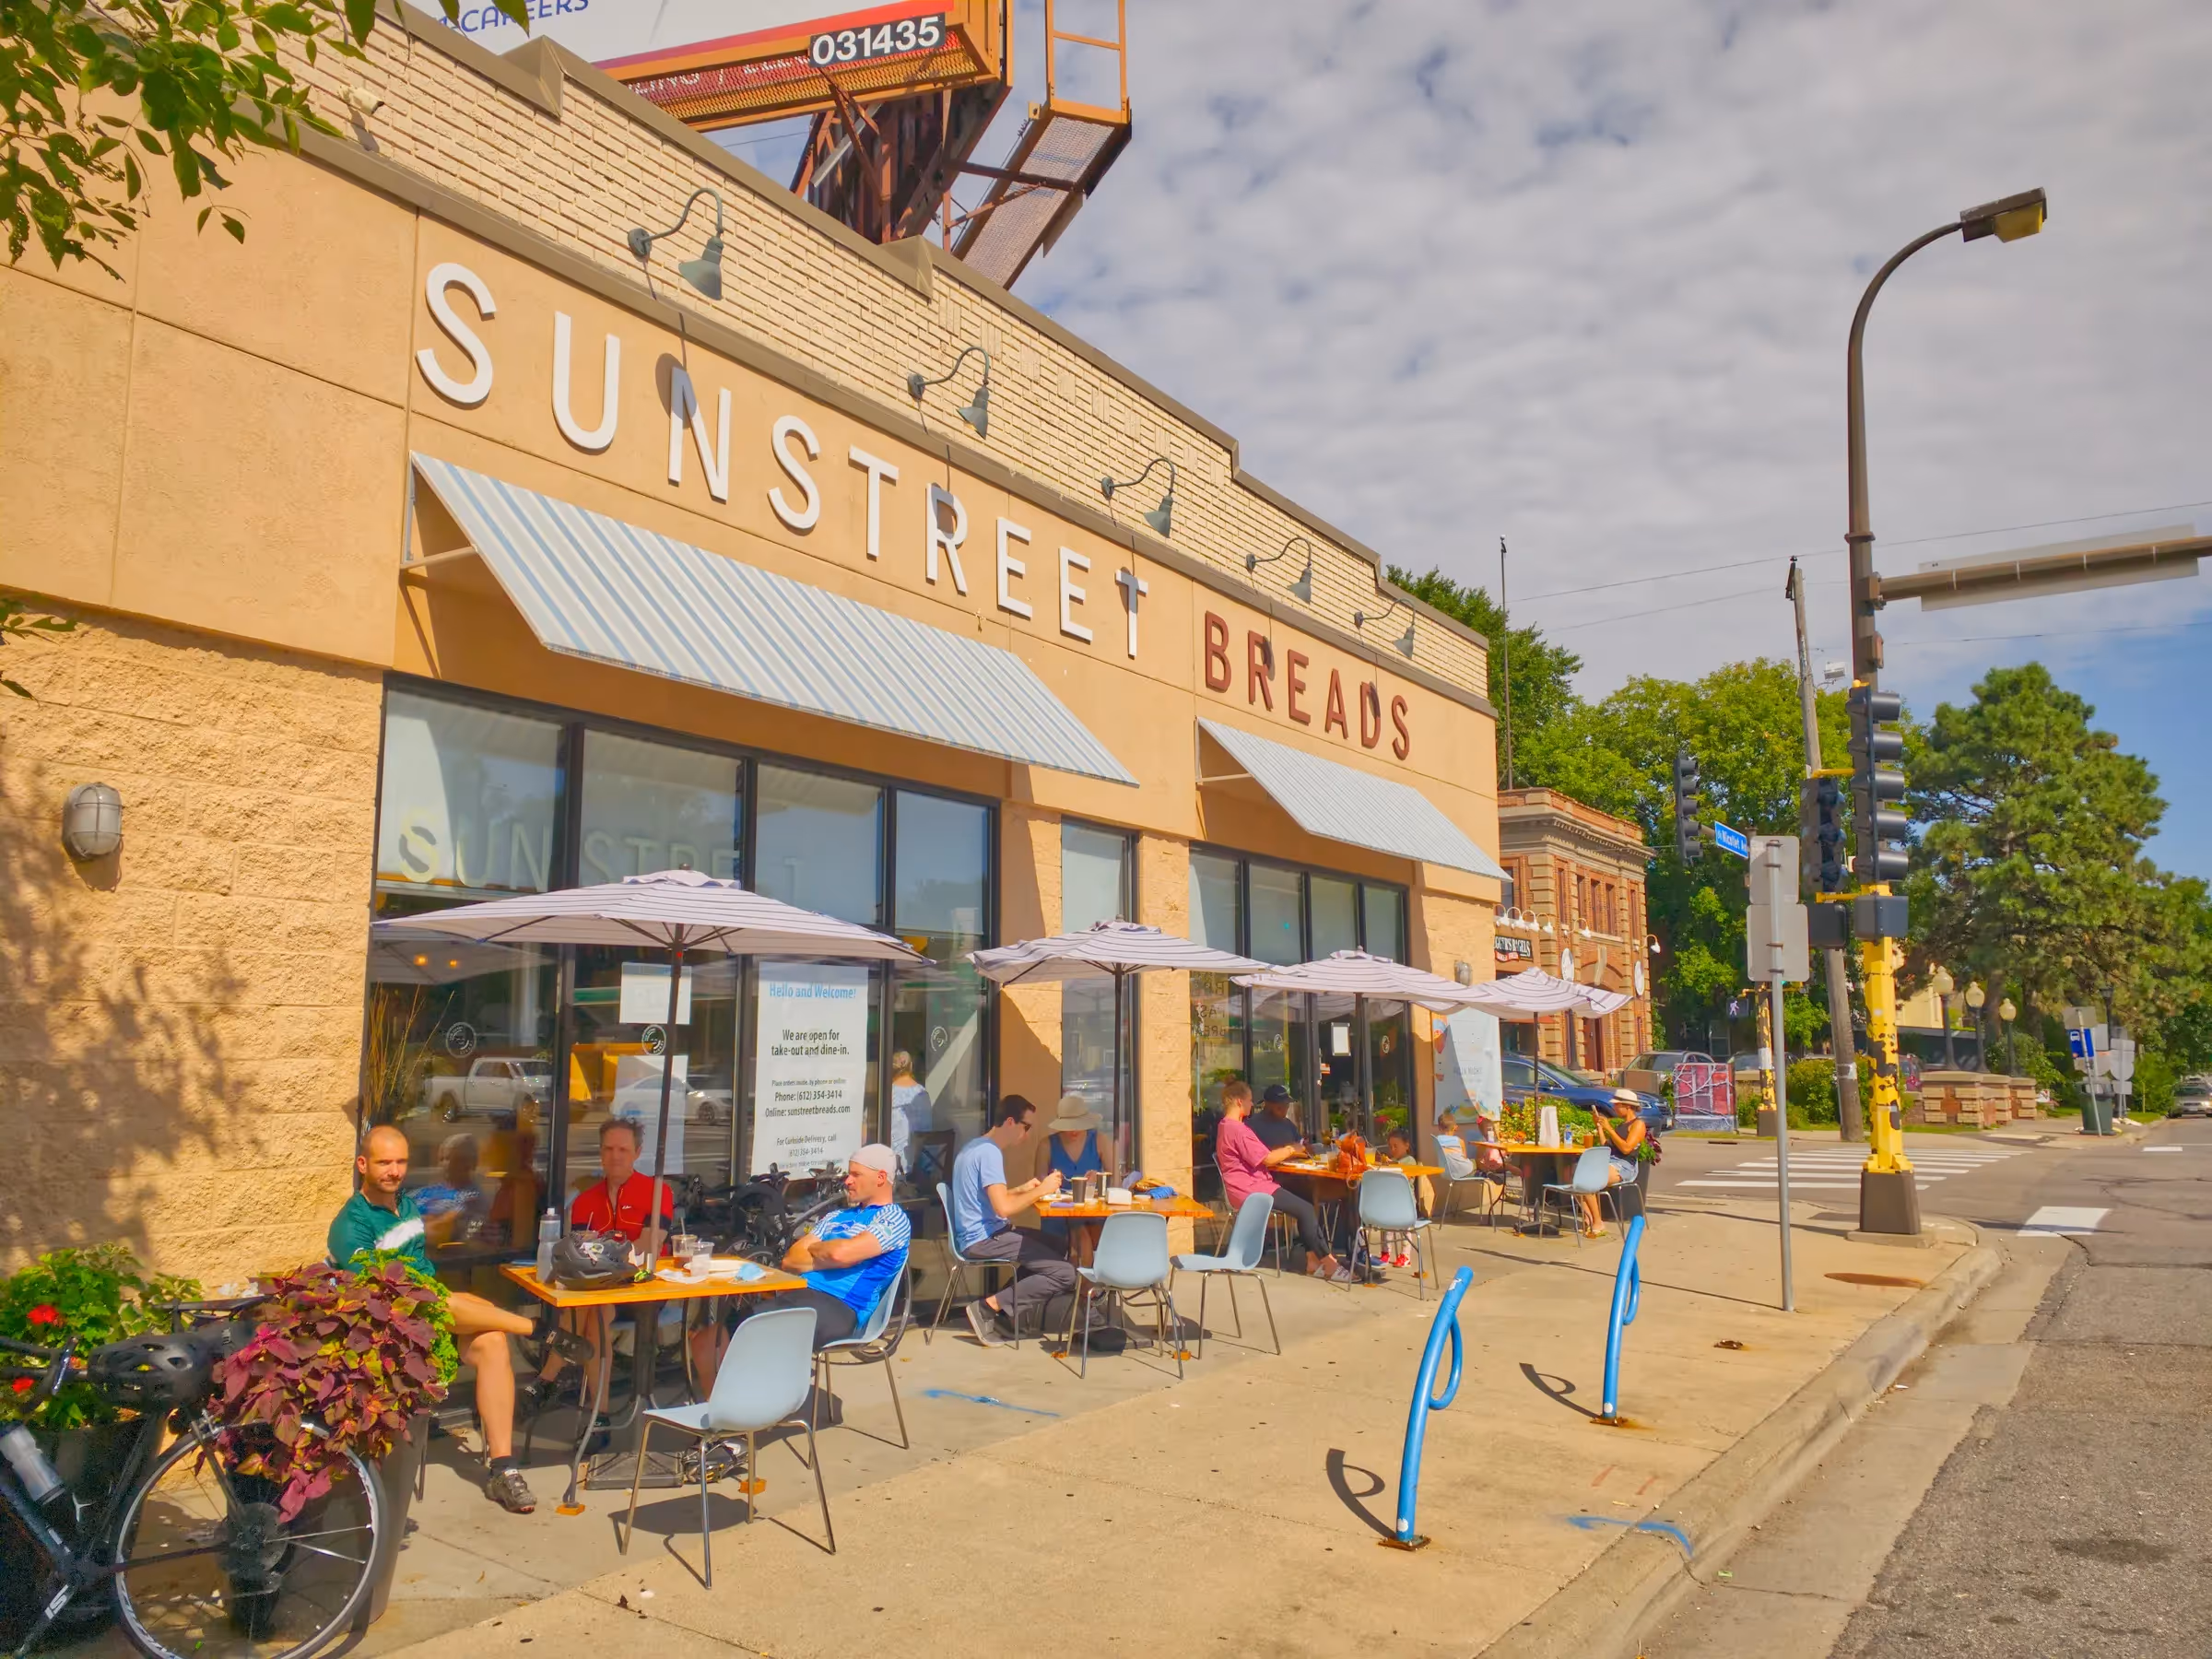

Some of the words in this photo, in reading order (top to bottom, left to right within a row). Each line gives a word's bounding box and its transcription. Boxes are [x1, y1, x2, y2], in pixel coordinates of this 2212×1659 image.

[812, 16, 939, 65] 031435
[1205, 611, 1409, 760] BREADS
[770, 982, 794, 996] Hello
[795, 982, 812, 997] and
[815, 983, 856, 998] Welcome!
[782, 1030, 794, 1041] We
[795, 1031, 807, 1041] are
[808, 1031, 828, 1042] open
[829, 1029, 840, 1041] for
[771, 1043, 804, 1055] take-out
[805, 1045, 819, 1055] and
[820, 1043, 850, 1055] dine-in.
[774, 1091, 796, 1101] Phone:
[796, 1090, 812, 1101] (612)
[813, 1089, 842, 1100] 354-3414
[765, 1107, 787, 1117] Online:
[787, 1104, 851, 1116] sunstreetbreads.com
